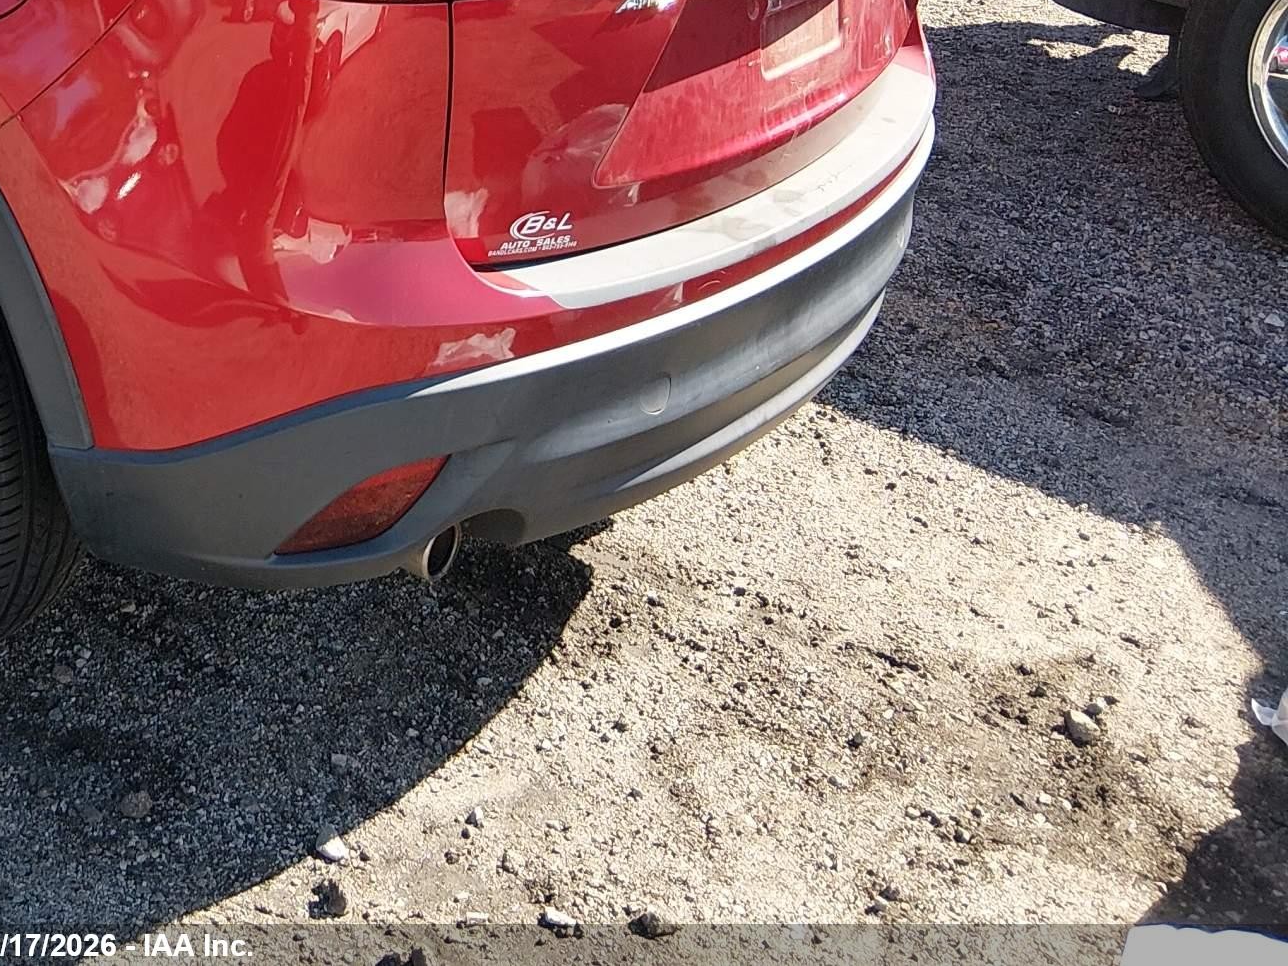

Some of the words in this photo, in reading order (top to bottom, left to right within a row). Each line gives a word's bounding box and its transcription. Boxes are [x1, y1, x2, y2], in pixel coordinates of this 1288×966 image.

[520, 212, 573, 235] B&L
[500, 240, 530, 250] AUTO
[536, 235, 571, 246] SALES
